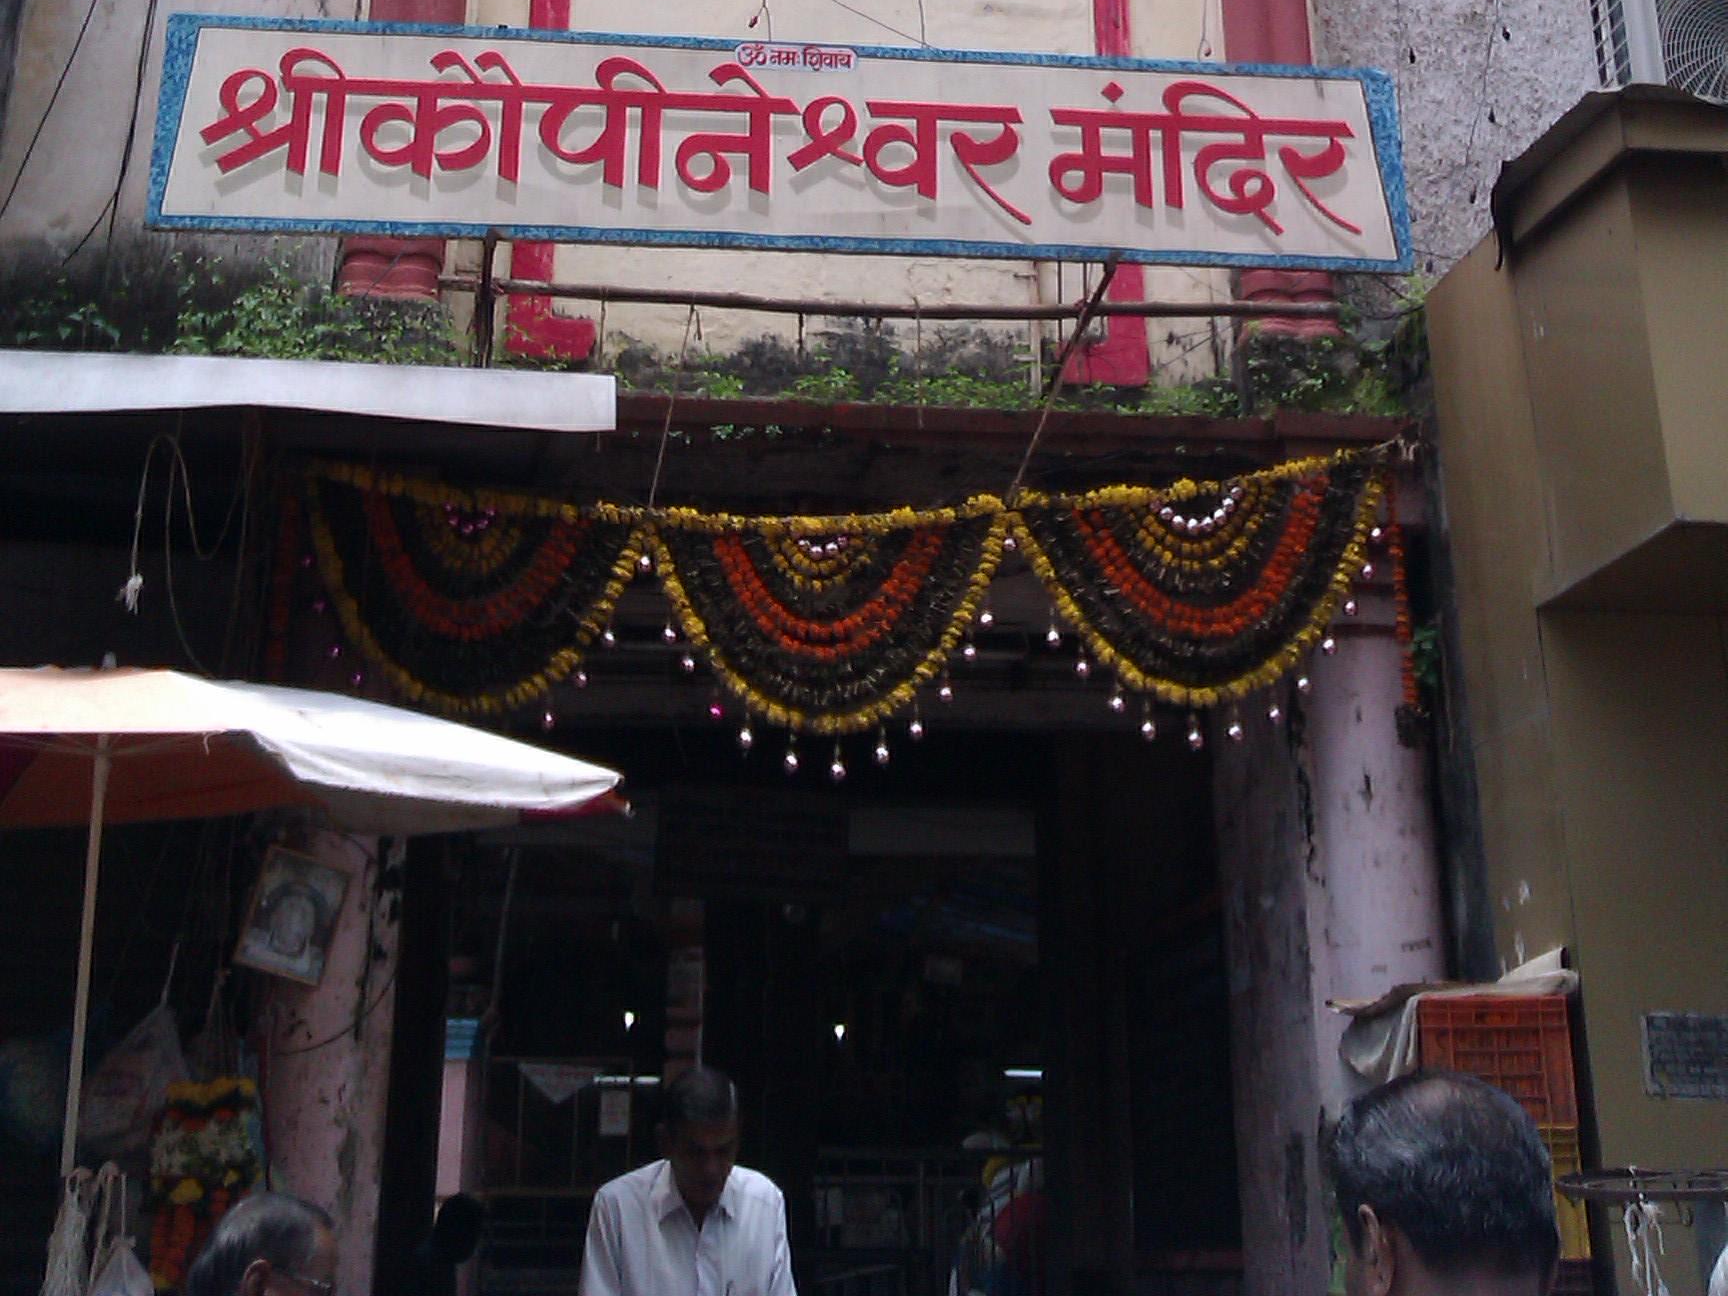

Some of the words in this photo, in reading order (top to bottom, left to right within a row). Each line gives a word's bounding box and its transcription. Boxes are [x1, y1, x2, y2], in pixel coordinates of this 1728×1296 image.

[737, 44, 767, 67] ॐ
[769, 49, 800, 67] नमः
[802, 45, 852, 71] शिवाय
[199, 47, 1032, 225] श्रीकौपीनेश्वर
[1049, 80, 1362, 236] मंदिर
